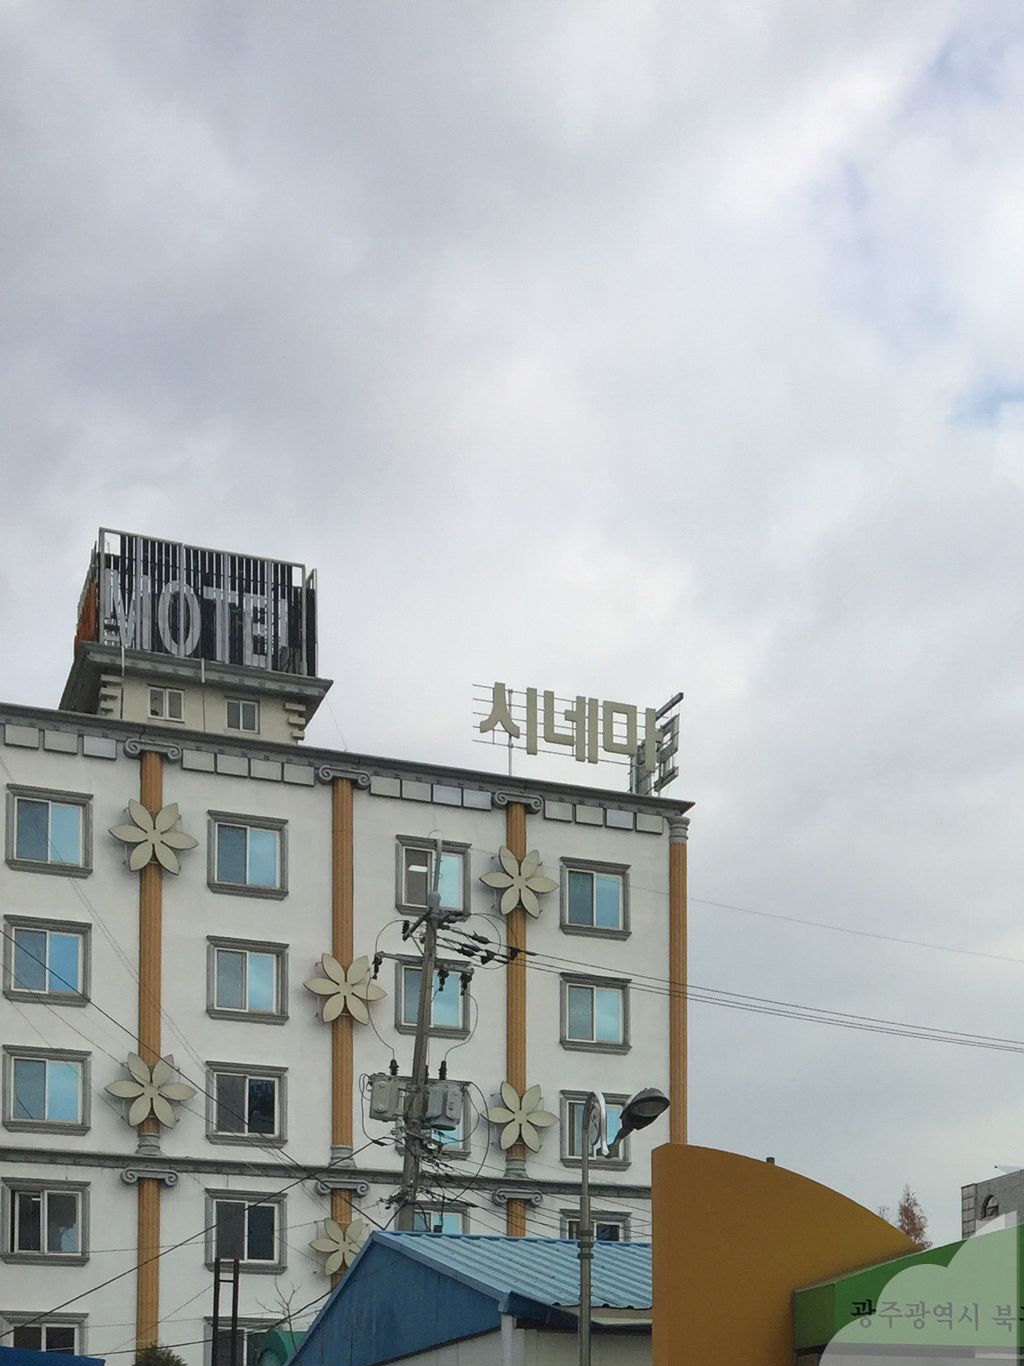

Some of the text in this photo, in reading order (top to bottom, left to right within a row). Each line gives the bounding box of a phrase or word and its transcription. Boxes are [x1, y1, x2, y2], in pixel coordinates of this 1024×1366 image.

[103, 568, 300, 675] MOTEL
[479, 681, 665, 774] 시네마
[850, 1298, 979, 1332] 광주광역시
